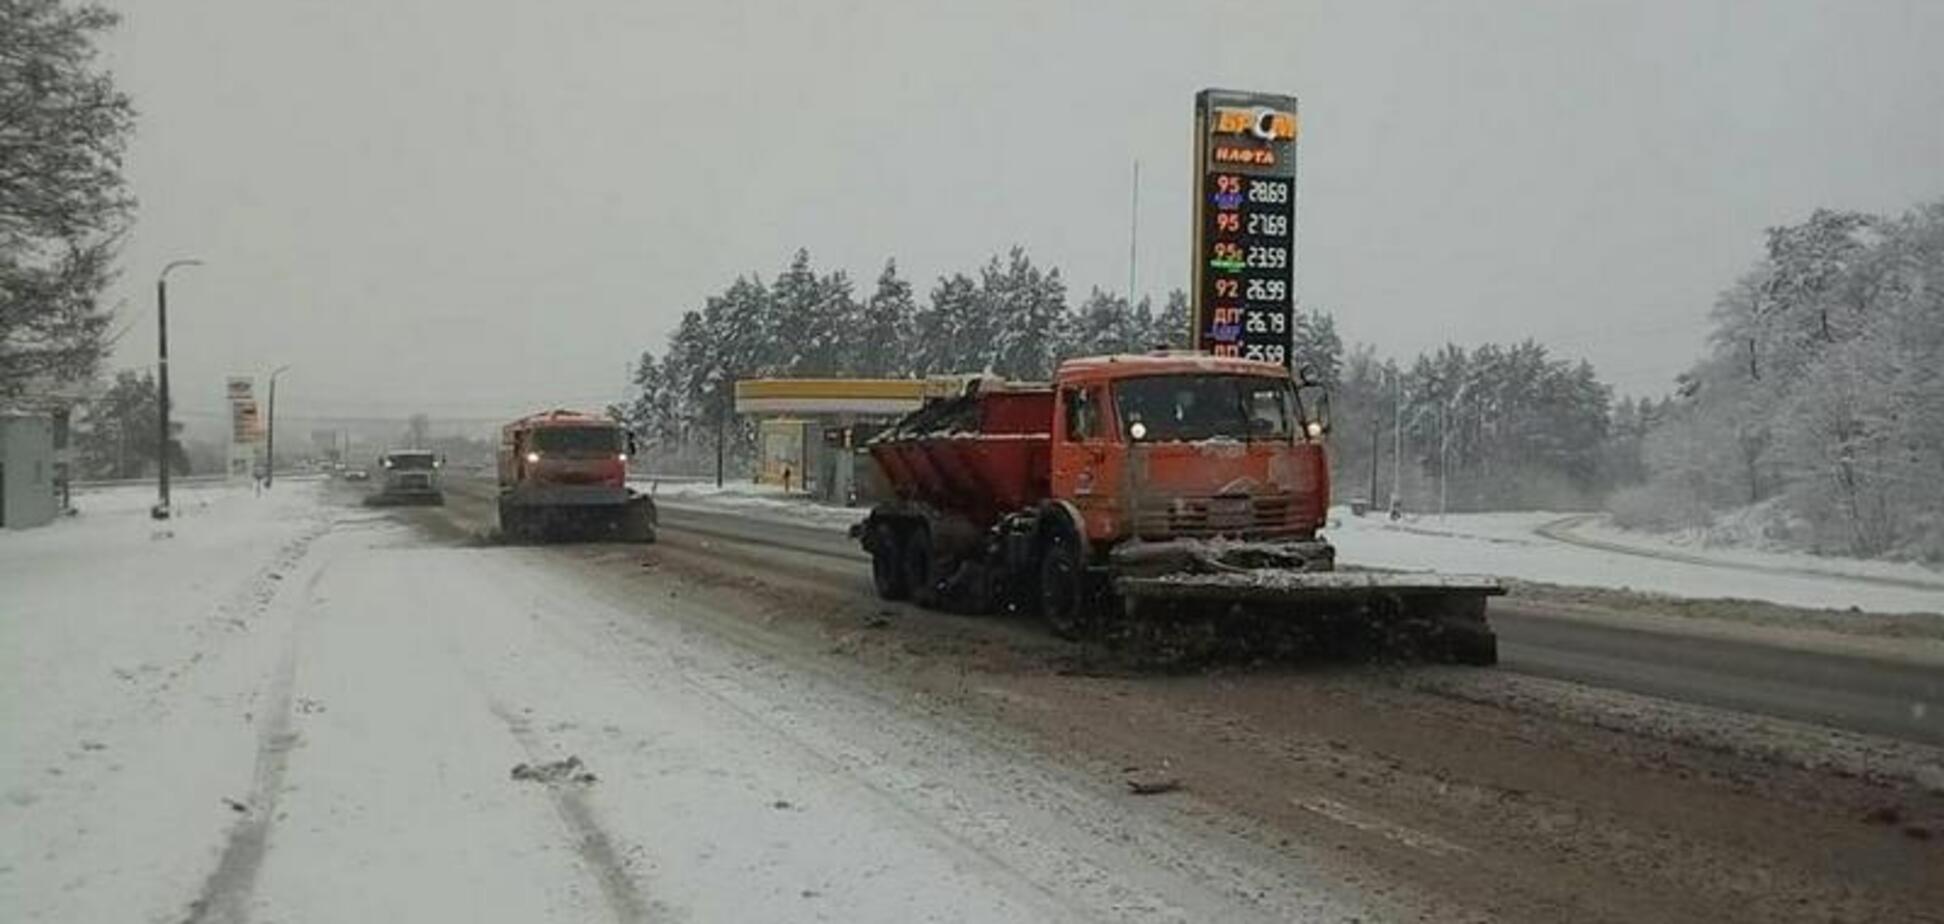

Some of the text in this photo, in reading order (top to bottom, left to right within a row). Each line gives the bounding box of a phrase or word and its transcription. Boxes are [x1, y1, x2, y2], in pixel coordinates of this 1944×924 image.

[1215, 147, 1275, 165] НАФТА
[1217, 175, 1240, 194] 95
[1216, 213, 1239, 232] 95
[1215, 279, 1239, 298] 92
